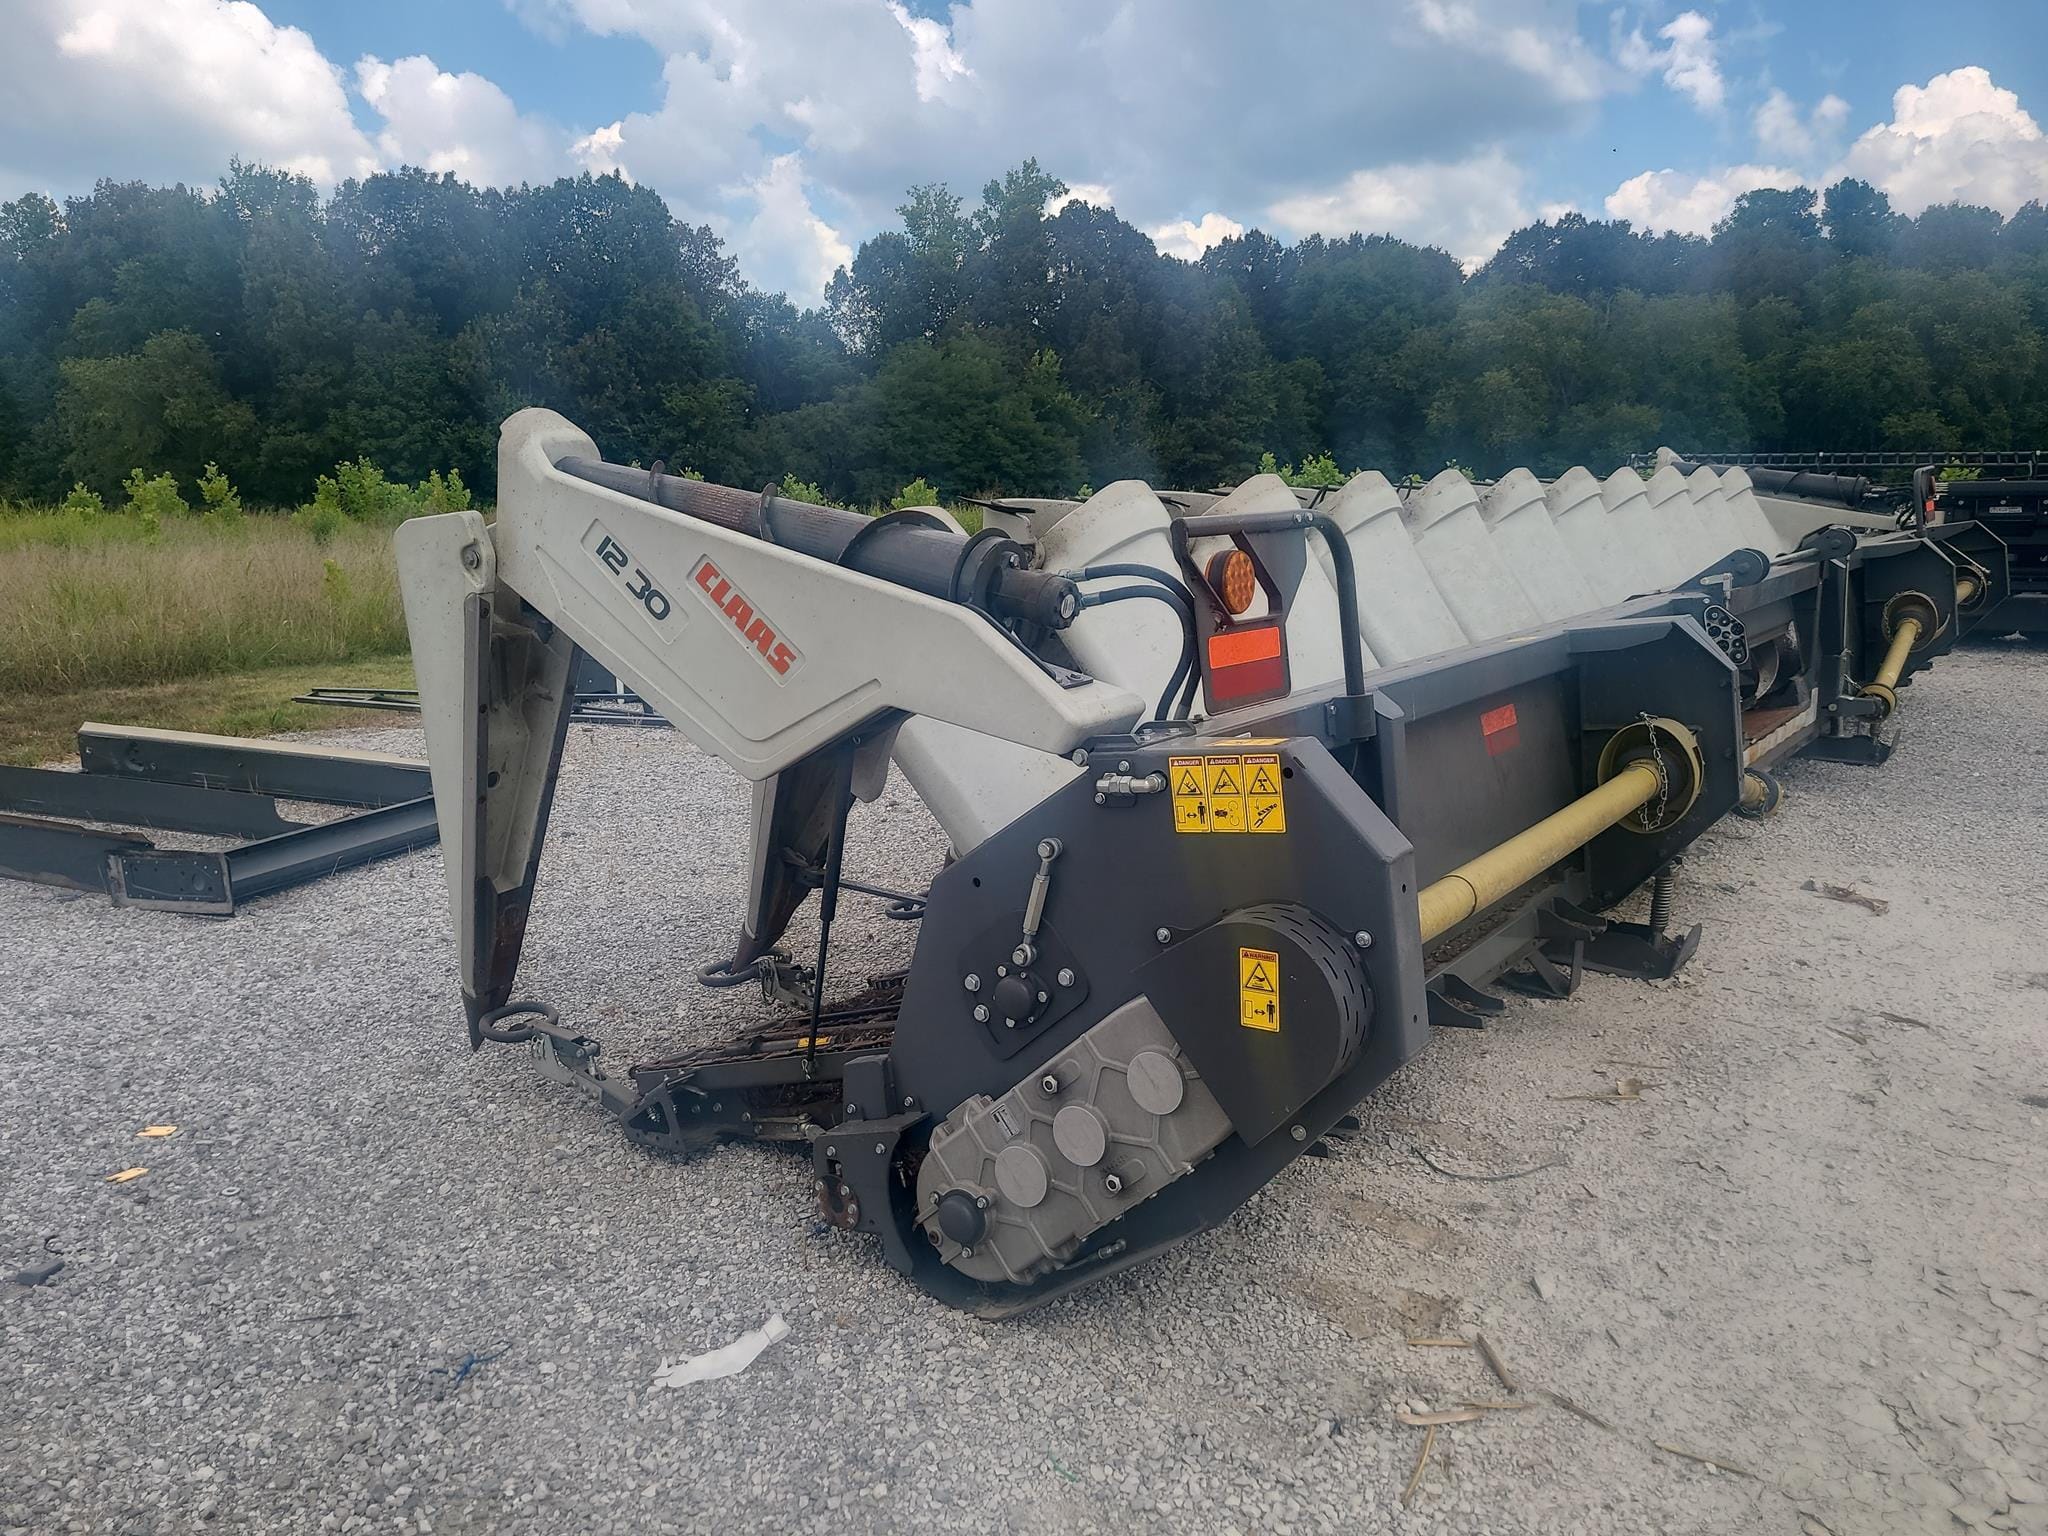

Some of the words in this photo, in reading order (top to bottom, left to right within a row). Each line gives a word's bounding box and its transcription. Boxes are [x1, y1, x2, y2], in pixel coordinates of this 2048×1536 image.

[595, 535, 629, 576] 12
[625, 568, 671, 621] 30
[694, 561, 798, 676] CLAAS
[1249, 952, 1275, 961] WARNING
